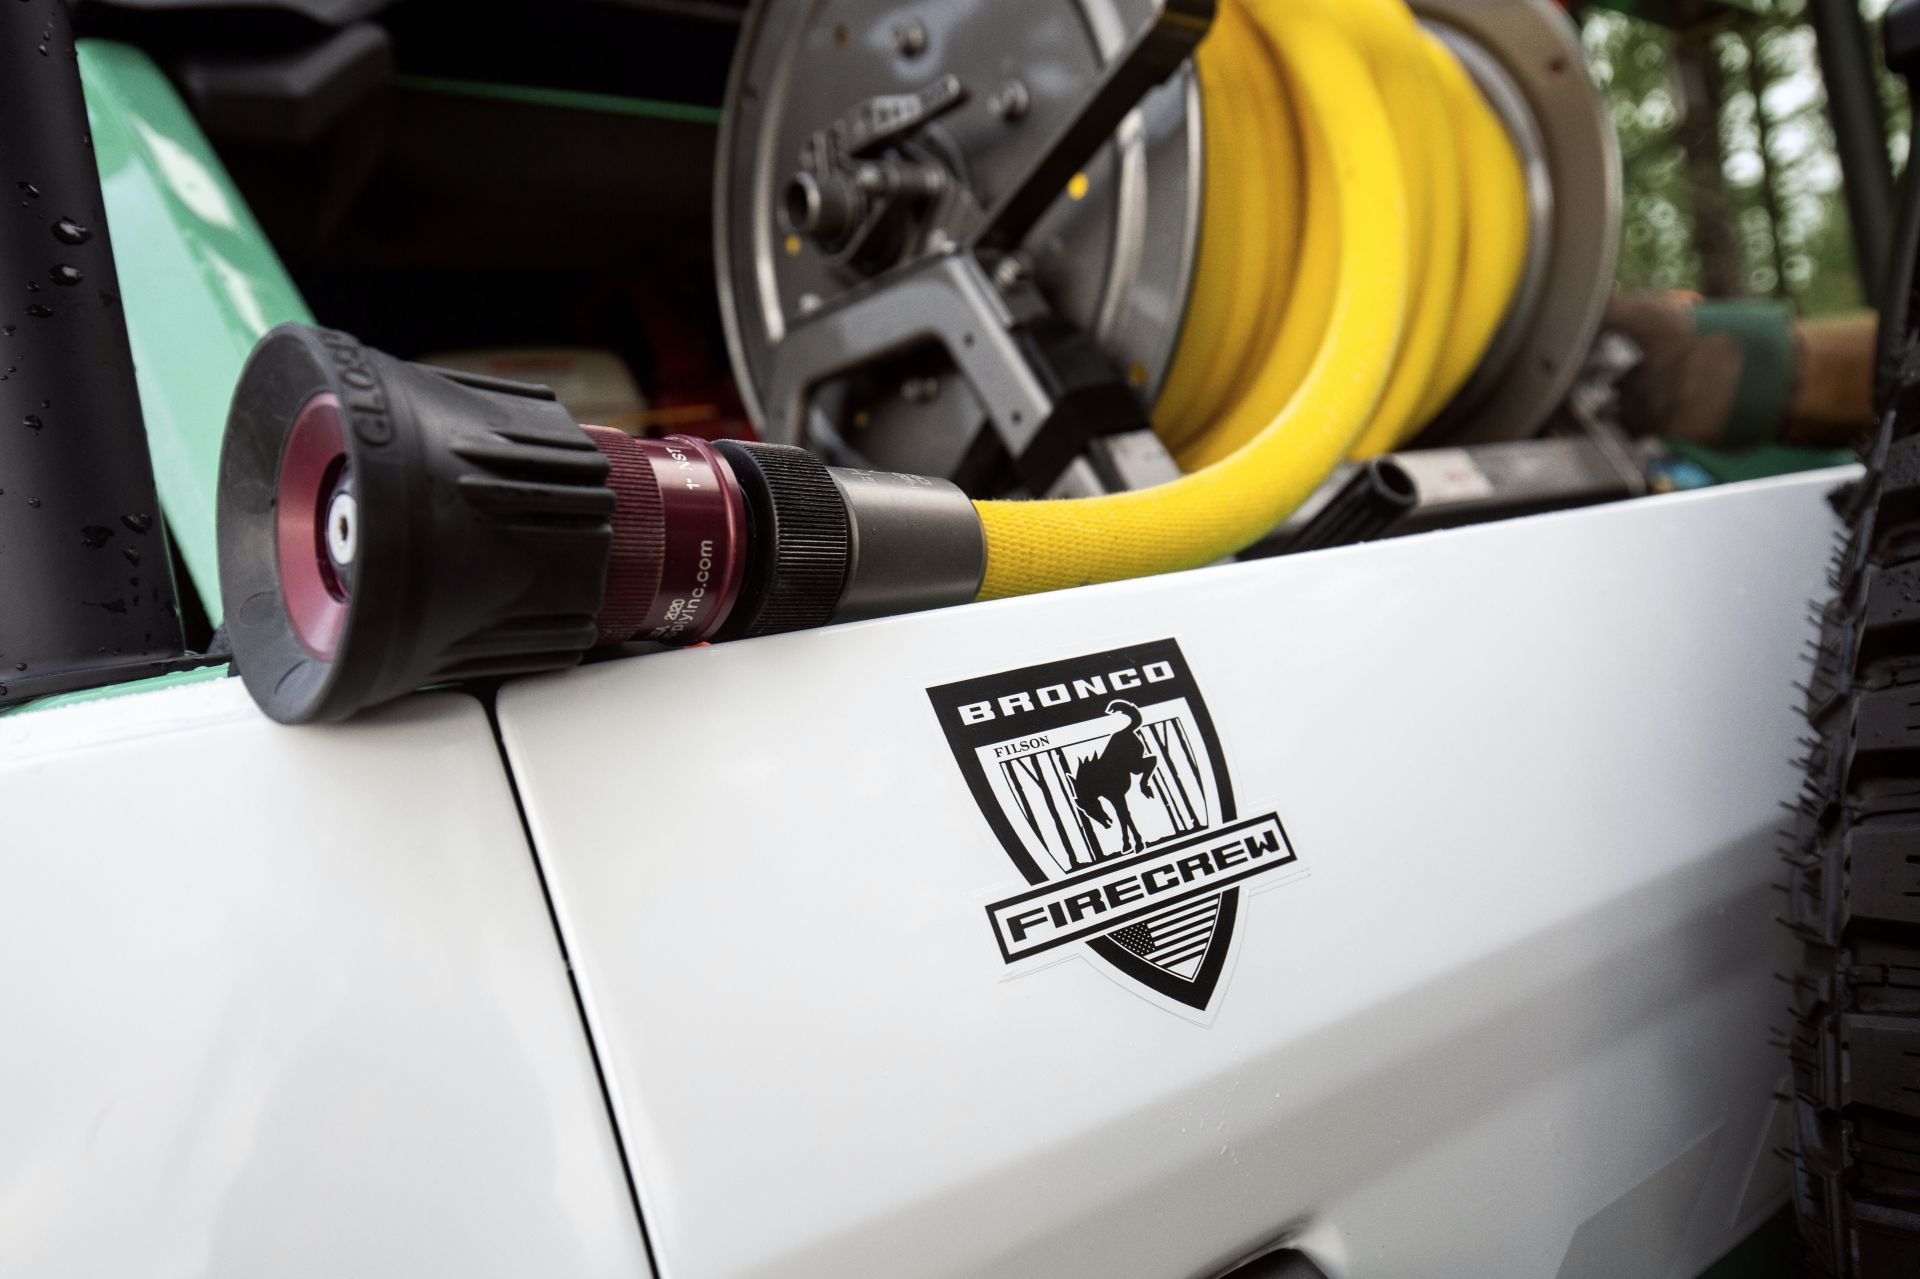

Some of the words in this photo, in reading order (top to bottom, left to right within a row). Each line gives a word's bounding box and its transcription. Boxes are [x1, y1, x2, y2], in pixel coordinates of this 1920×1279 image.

[665, 447, 694, 471] NST
[663, 598, 686, 621] 2020
[957, 660, 1177, 727] BRONCO
[993, 735, 1051, 758] FILSON
[1005, 830, 1281, 943] FIRECREW
